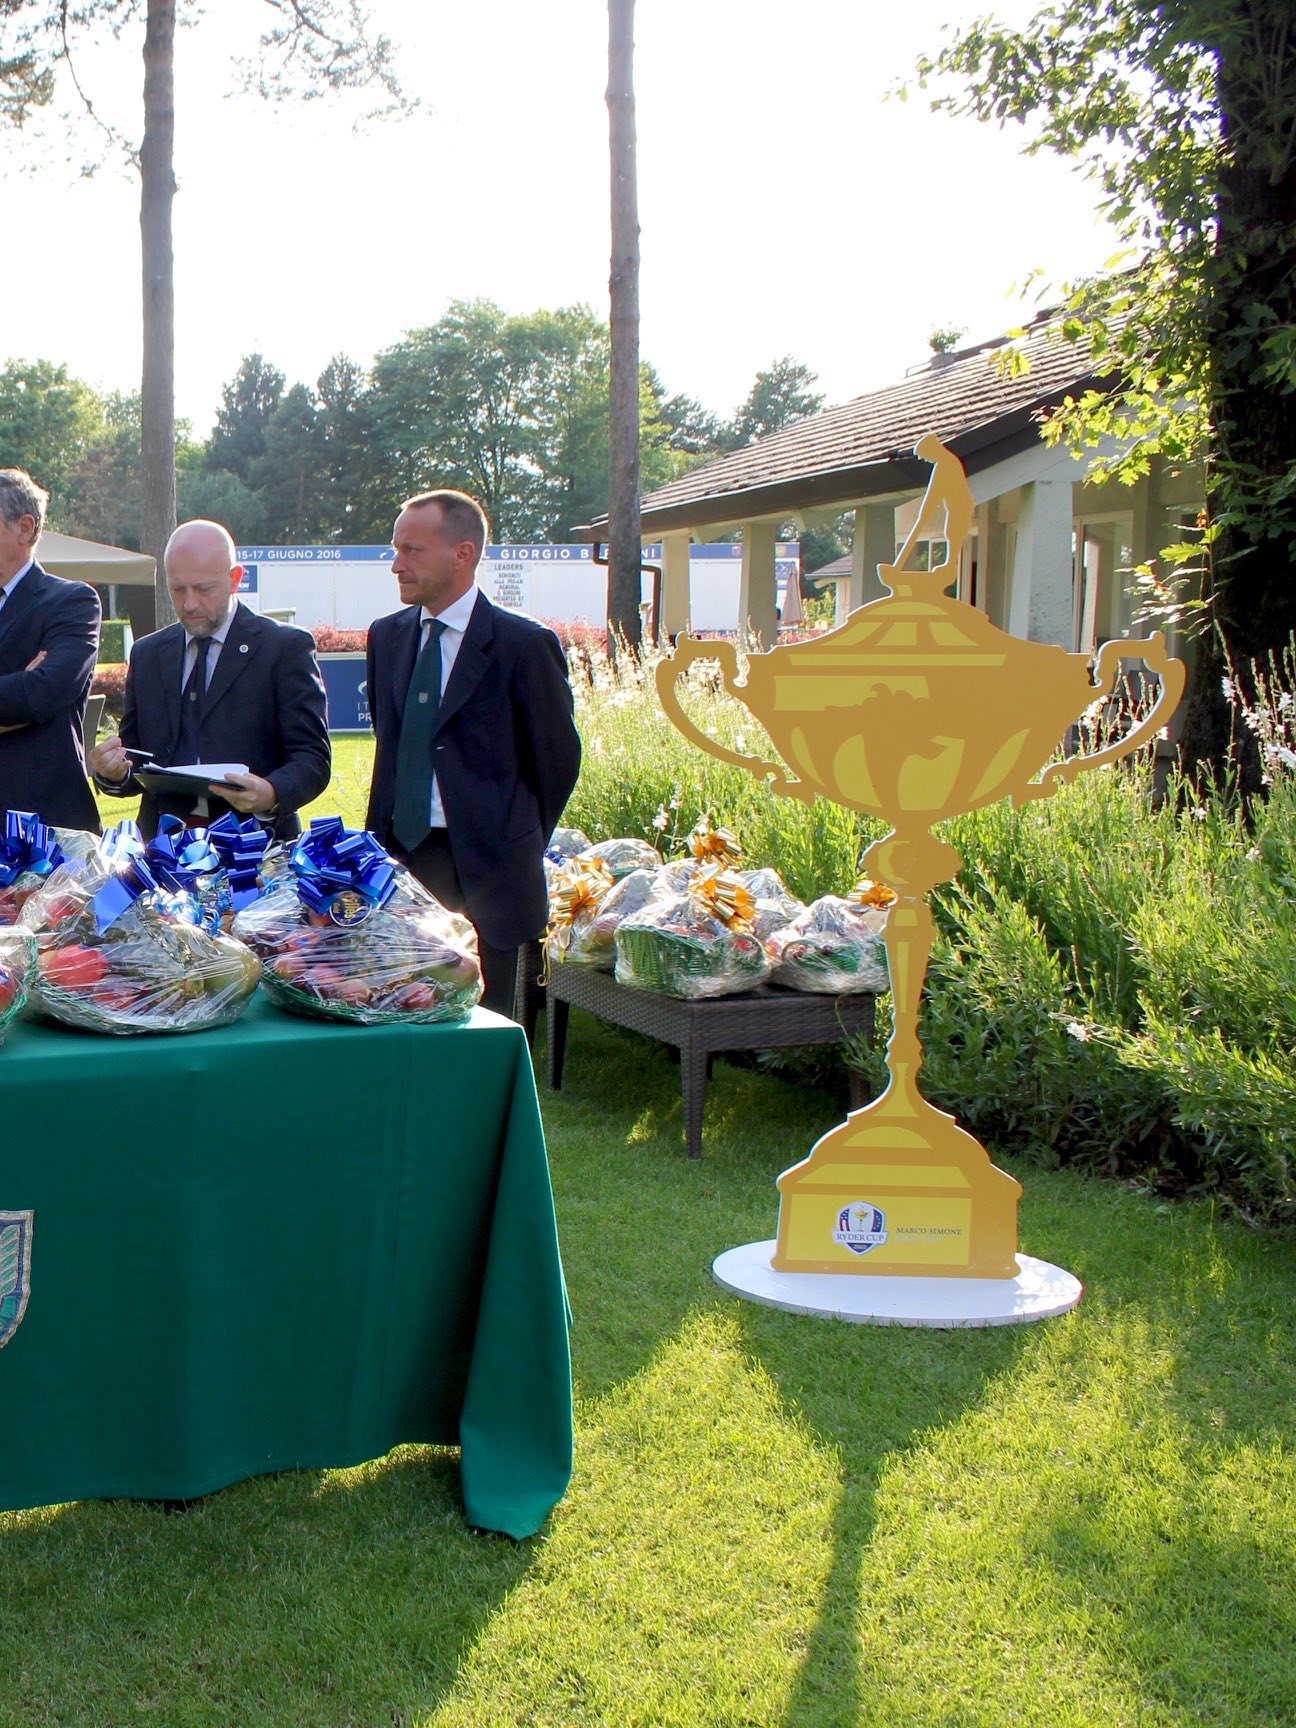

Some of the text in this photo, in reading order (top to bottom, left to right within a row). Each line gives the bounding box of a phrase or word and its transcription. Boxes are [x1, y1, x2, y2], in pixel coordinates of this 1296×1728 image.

[237, 550, 341, 560] 15-17 GIUGNO 2016
[500, 549, 570, 559] GIORGIO
[928, 1228, 963, 1236] SIMONE
[836, 1233, 884, 1241] RYDER CUP
